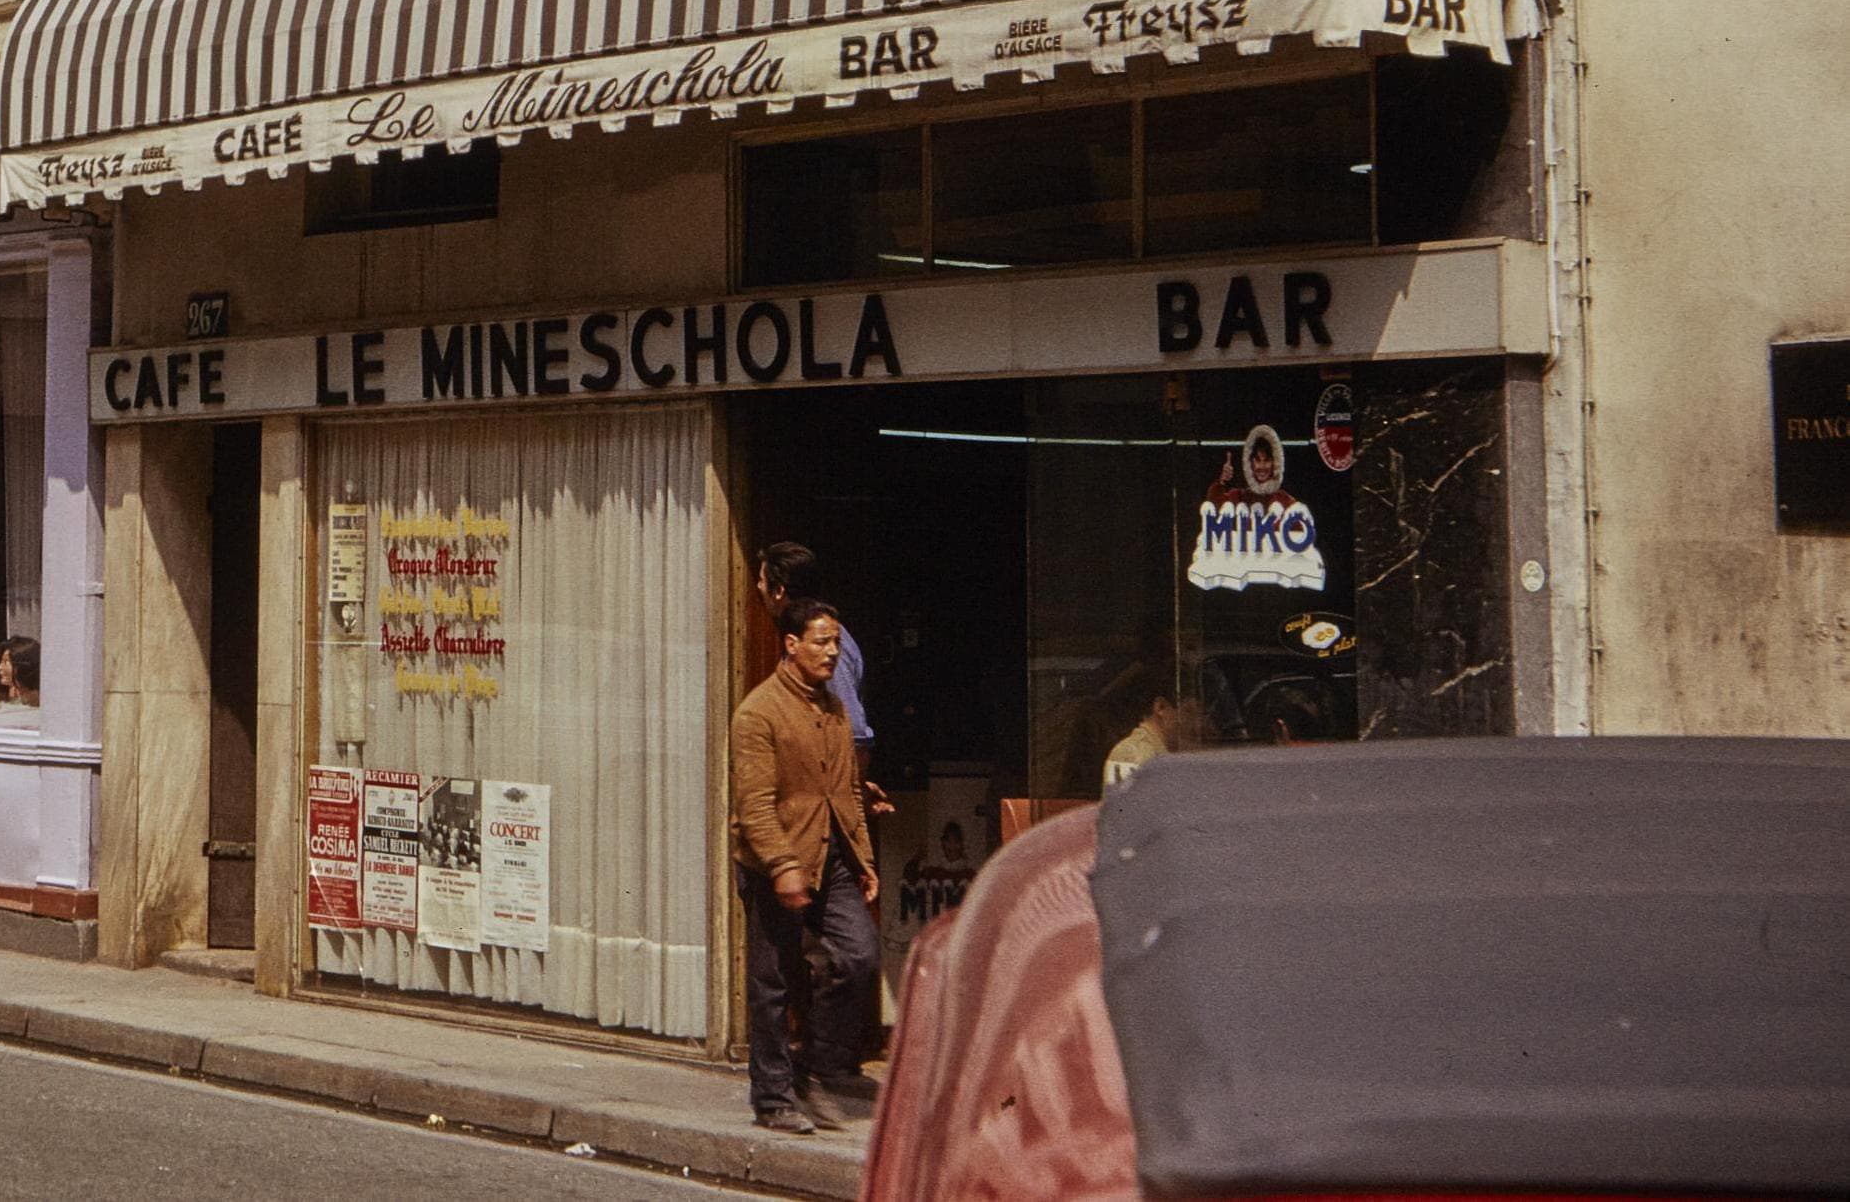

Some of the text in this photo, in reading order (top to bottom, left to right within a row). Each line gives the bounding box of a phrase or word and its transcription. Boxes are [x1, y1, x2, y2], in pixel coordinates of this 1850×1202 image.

[840, 26, 938, 80] BAR
[994, 34, 1062, 60] D'ALSACE
[347, 39, 785, 146] Le Mineschola
[213, 112, 303, 164] CAFÉ
[189, 299, 224, 335] 267
[104, 271, 1334, 410] CAFE LE MINESCHOLA BAR
[1786, 417, 1850, 440] FRANC
[1203, 502, 1316, 554] MIKO
[310, 835, 357, 858] COSIMA
[317, 823, 350, 839] RENÉE
[489, 821, 541, 841] CONCERT
